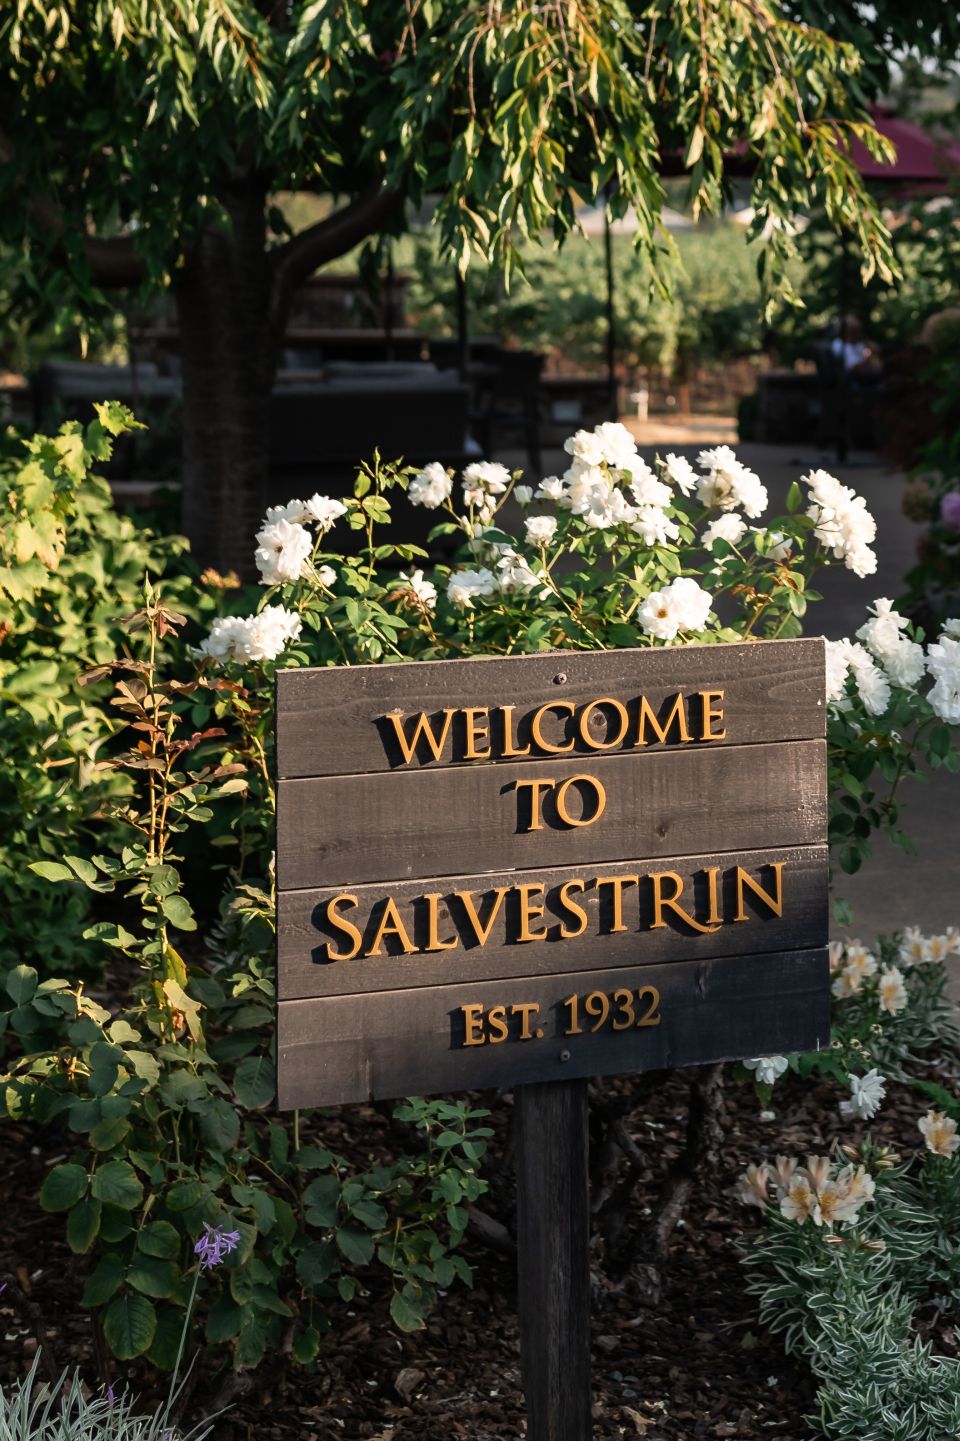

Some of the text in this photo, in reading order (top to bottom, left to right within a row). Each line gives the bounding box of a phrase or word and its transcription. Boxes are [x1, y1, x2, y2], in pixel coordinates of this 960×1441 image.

[385, 689, 727, 764] WELCOME
[514, 773, 607, 830] TO
[325, 862, 786, 961] SALVESTRIN
[462, 986, 661, 1046] EST. 1932
